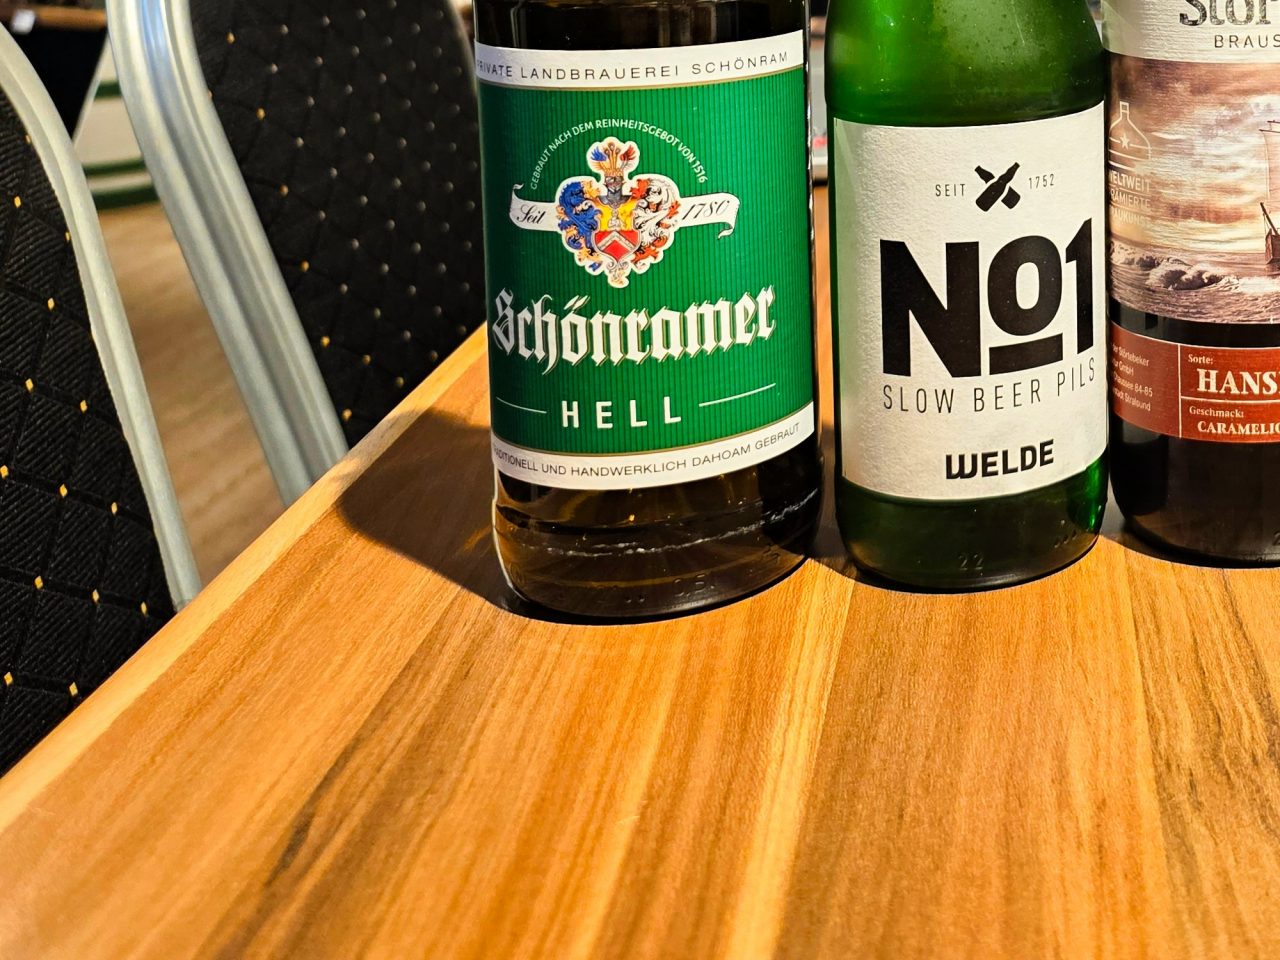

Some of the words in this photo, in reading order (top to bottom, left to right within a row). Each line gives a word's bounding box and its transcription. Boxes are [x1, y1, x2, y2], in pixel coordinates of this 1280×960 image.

[520, 64, 680, 81] LANDBRAUEREI
[692, 51, 789, 75] SCHÖNRAM
[530, 150, 552, 190] GEBRAUT
[548, 129, 573, 152] NACH
[573, 121, 594, 136] DEM
[595, 118, 681, 146] REINHEITSGEBOT
[677, 142, 696, 163] VON
[692, 159, 709, 184] 1516
[936, 183, 966, 197] SEIT
[1028, 173, 1055, 189] 1752
[682, 200, 730, 221] 1780
[492, 286, 777, 375] Schönramer
[1187, 353, 1214, 366] Sorte:
[883, 384, 954, 414] SLOW
[974, 379, 1041, 413] BEER
[1057, 357, 1095, 396] PILS
[561, 395, 682, 429] HELL
[1189, 405, 1245, 419] Geschmack:
[541, 462, 567, 475] UND
[570, 457, 687, 477] HANDWERKLICH
[692, 443, 752, 467] DAHOAM
[755, 422, 800, 450] GEBRAUT
[945, 438, 1054, 480] WELDE
